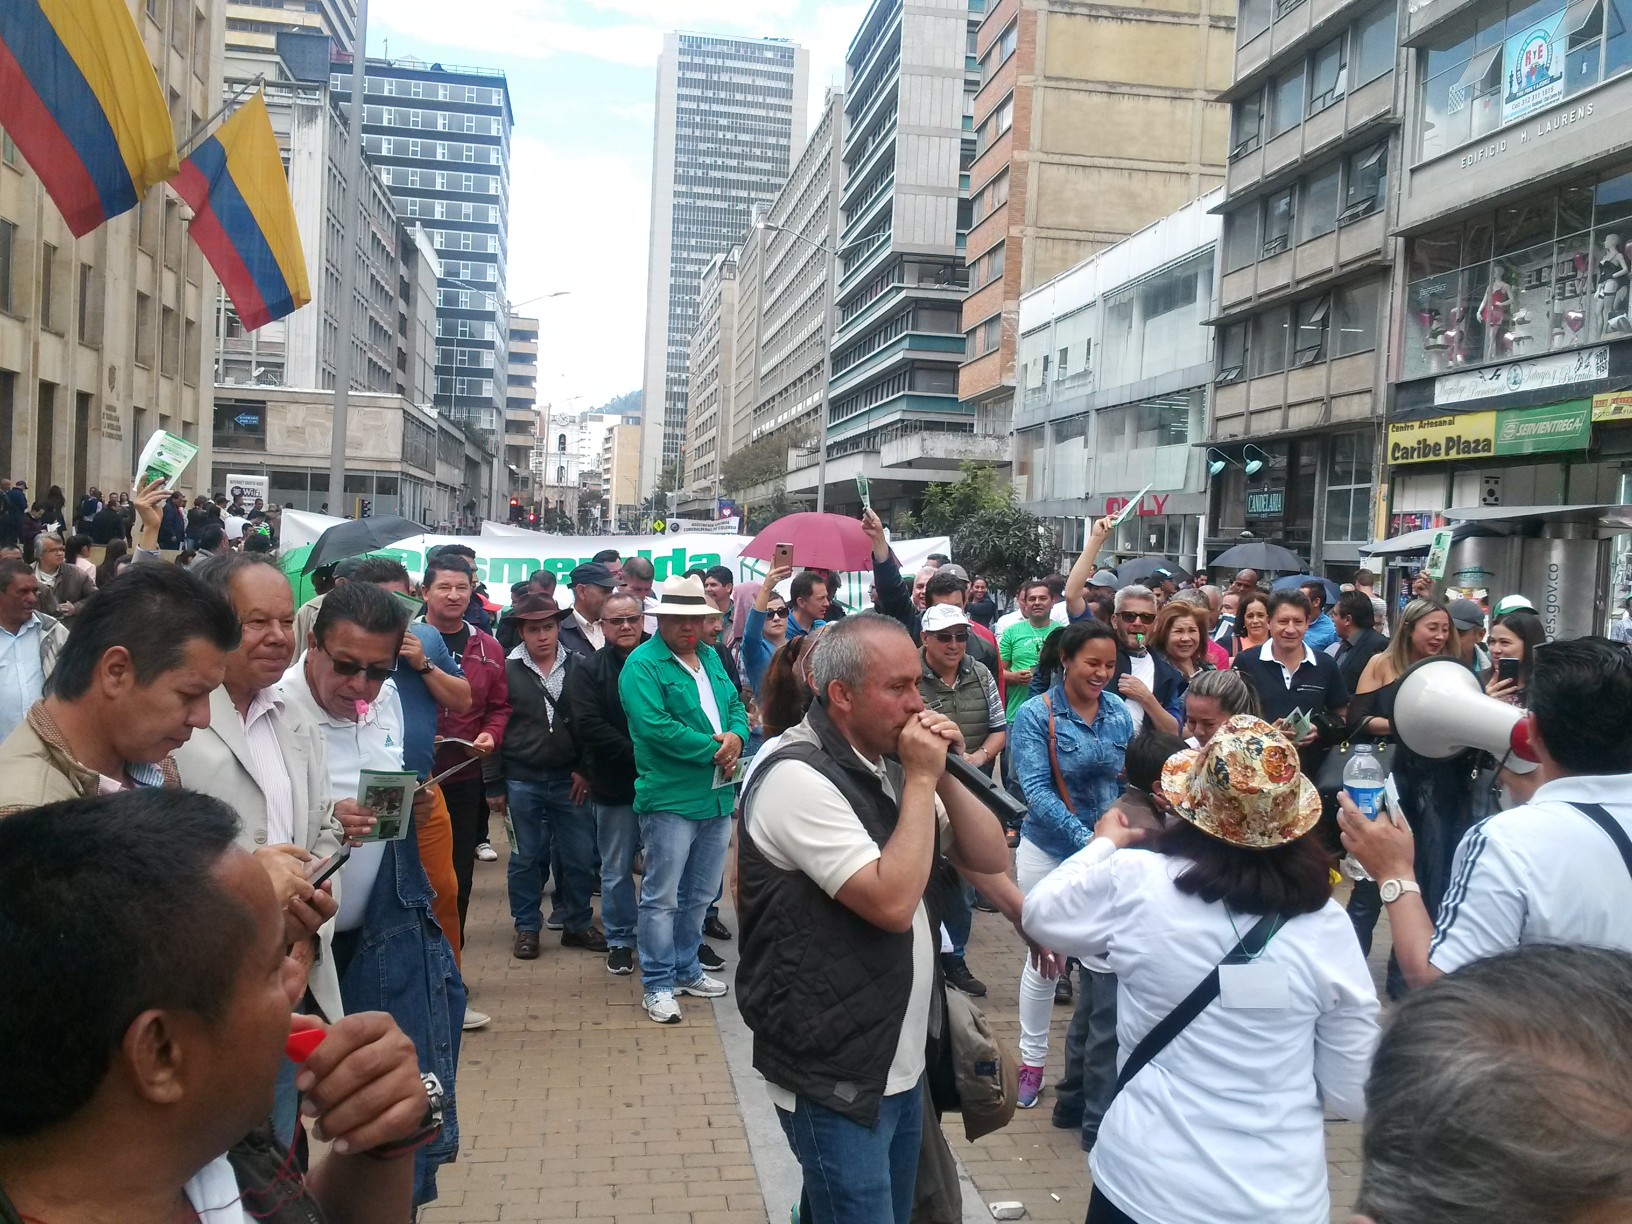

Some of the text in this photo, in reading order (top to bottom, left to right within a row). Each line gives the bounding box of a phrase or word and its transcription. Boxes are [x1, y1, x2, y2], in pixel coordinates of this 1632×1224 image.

[1525, 49, 1532, 67] R
[1538, 43, 1544, 60] E
[1461, 140, 1507, 169] EDIFICIO
[1520, 130, 1531, 144] M.
[1537, 103, 1594, 137] LAURENS
[1391, 415, 1456, 433] Centro Artesanal
[1516, 417, 1583, 437] SERVIENTREGA
[1391, 434, 1492, 462] Caribe Plaza
[1248, 493, 1282, 512] CANDELARIA
